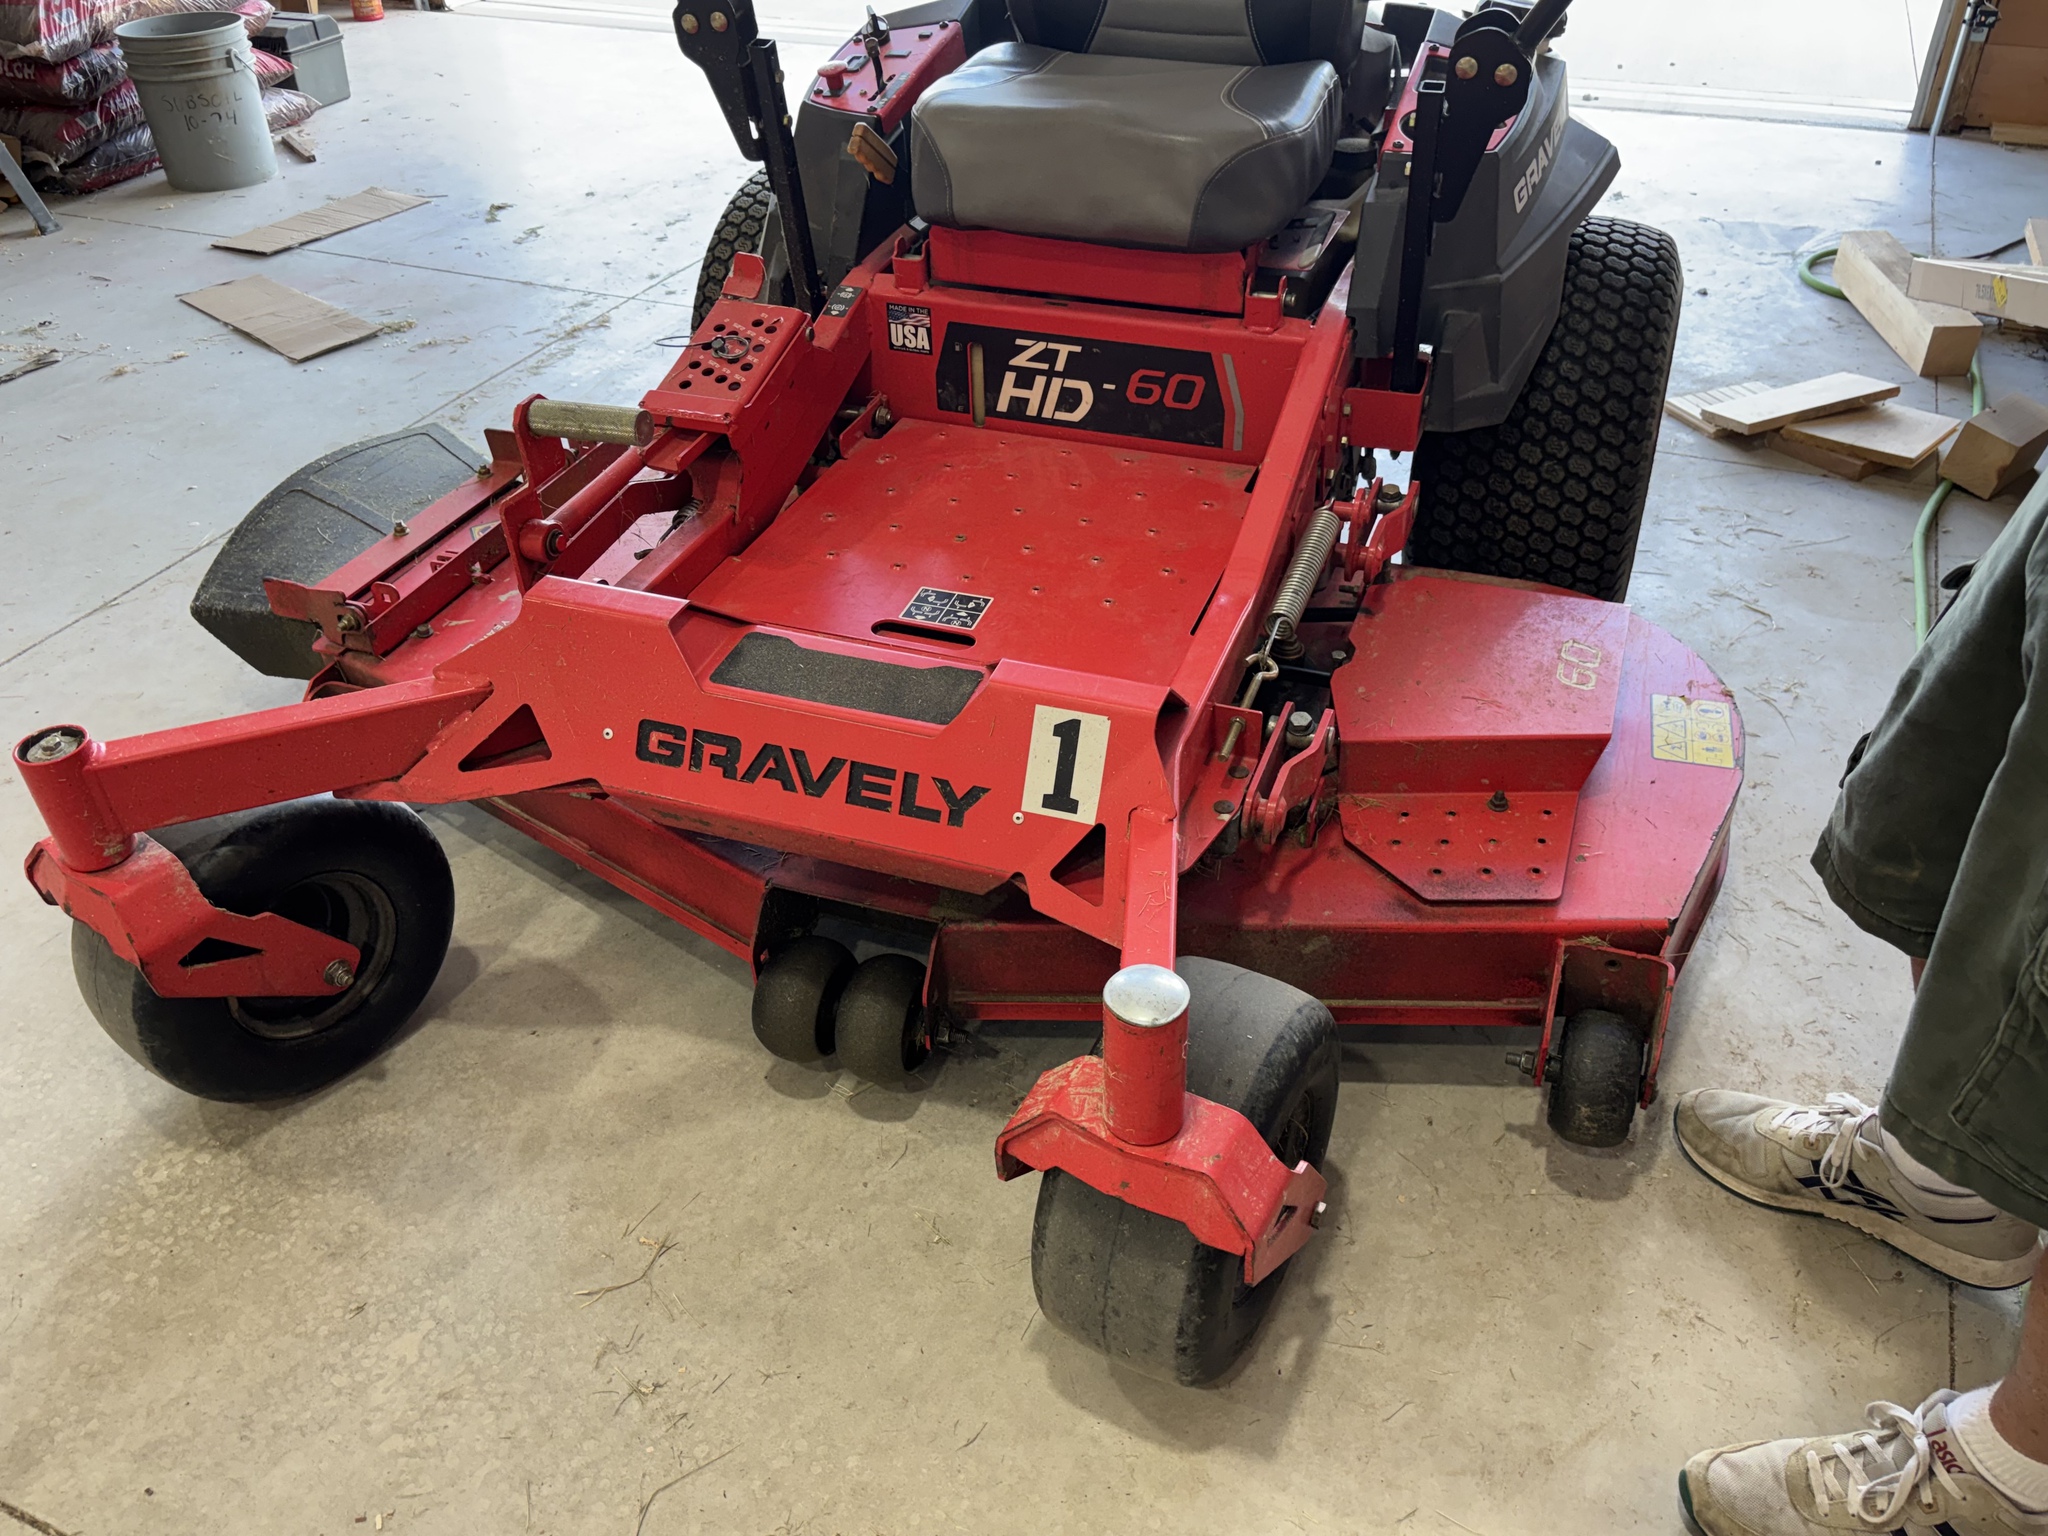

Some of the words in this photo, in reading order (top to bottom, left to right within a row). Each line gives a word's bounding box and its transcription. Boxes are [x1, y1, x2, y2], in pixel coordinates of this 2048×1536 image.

[889, 304, 907, 313] MADE
[916, 307, 929, 315] THE
[890, 323, 931, 350] USA
[1008, 338, 1082, 372] ZT
[1556, 639, 1601, 690] 60
[635, 718, 991, 828] GRAVELY
[1042, 718, 1081, 815] 1
[1931, 1439, 1964, 1474] asic
